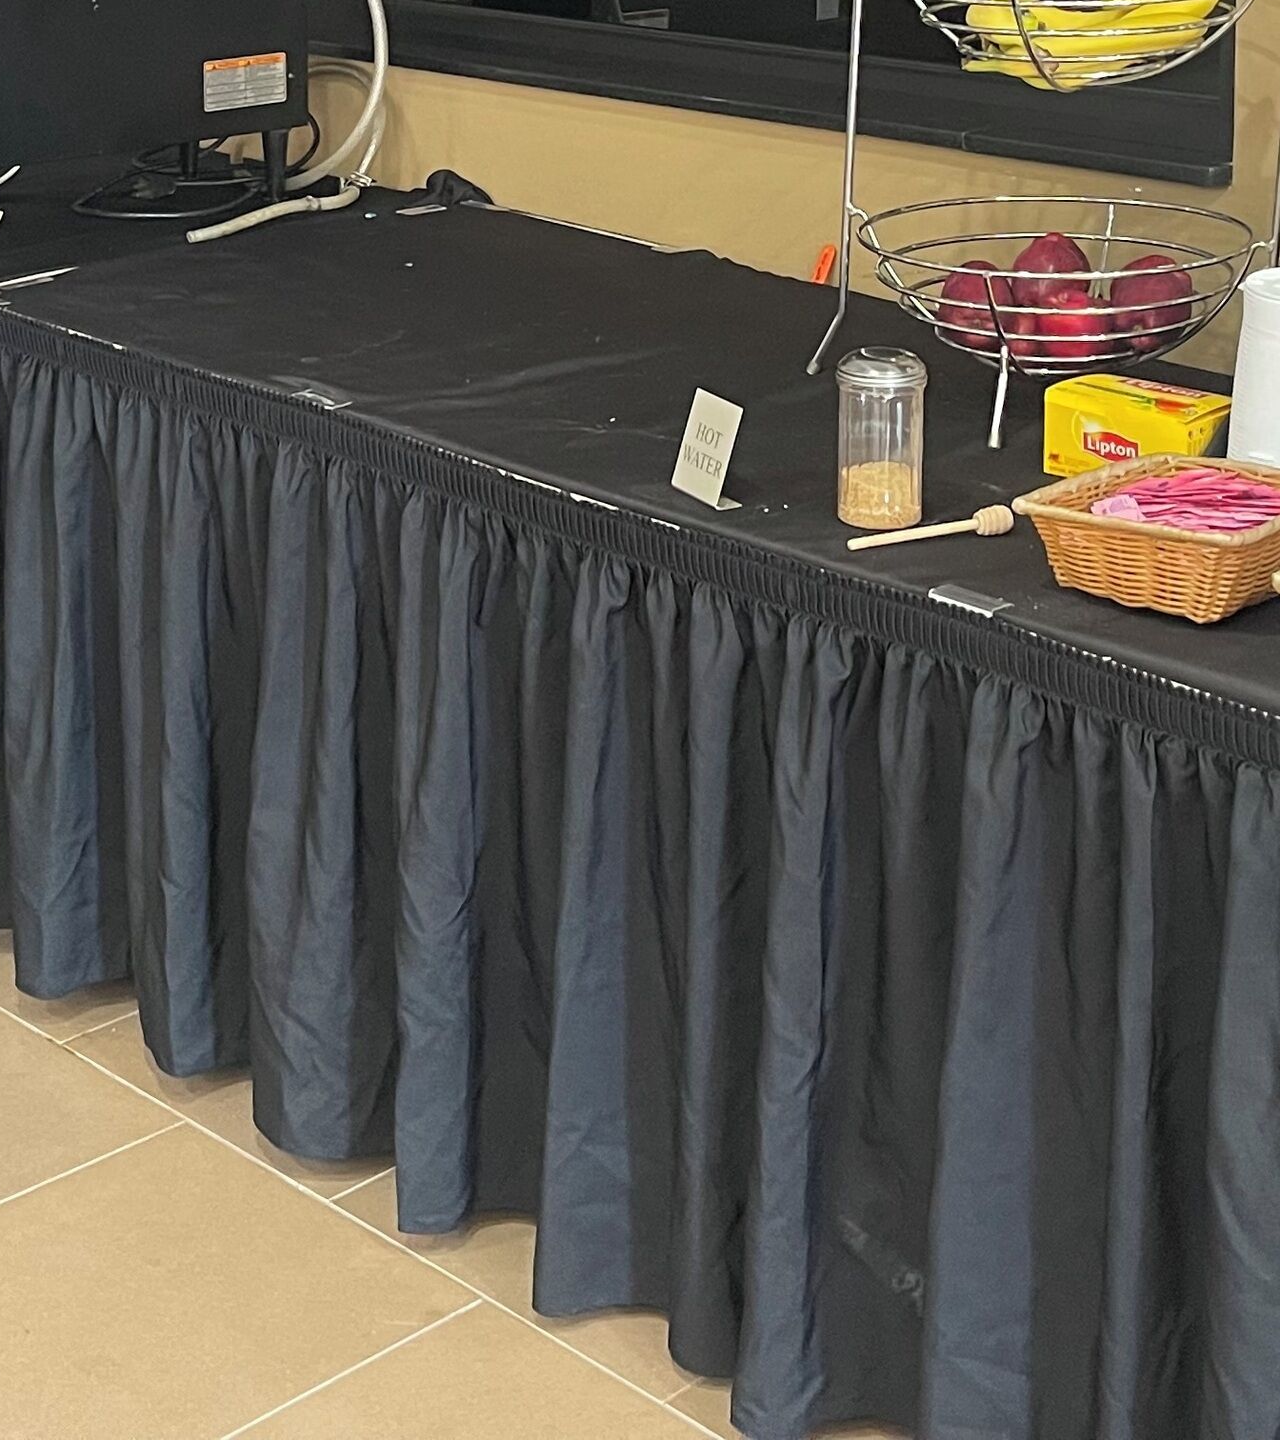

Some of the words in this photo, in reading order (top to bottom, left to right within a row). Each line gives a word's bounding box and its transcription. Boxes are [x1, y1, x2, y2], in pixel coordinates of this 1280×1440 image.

[695, 421, 724, 449] HOT
[1087, 434, 1136, 459] Lipton
[683, 444, 724, 479] WATER
